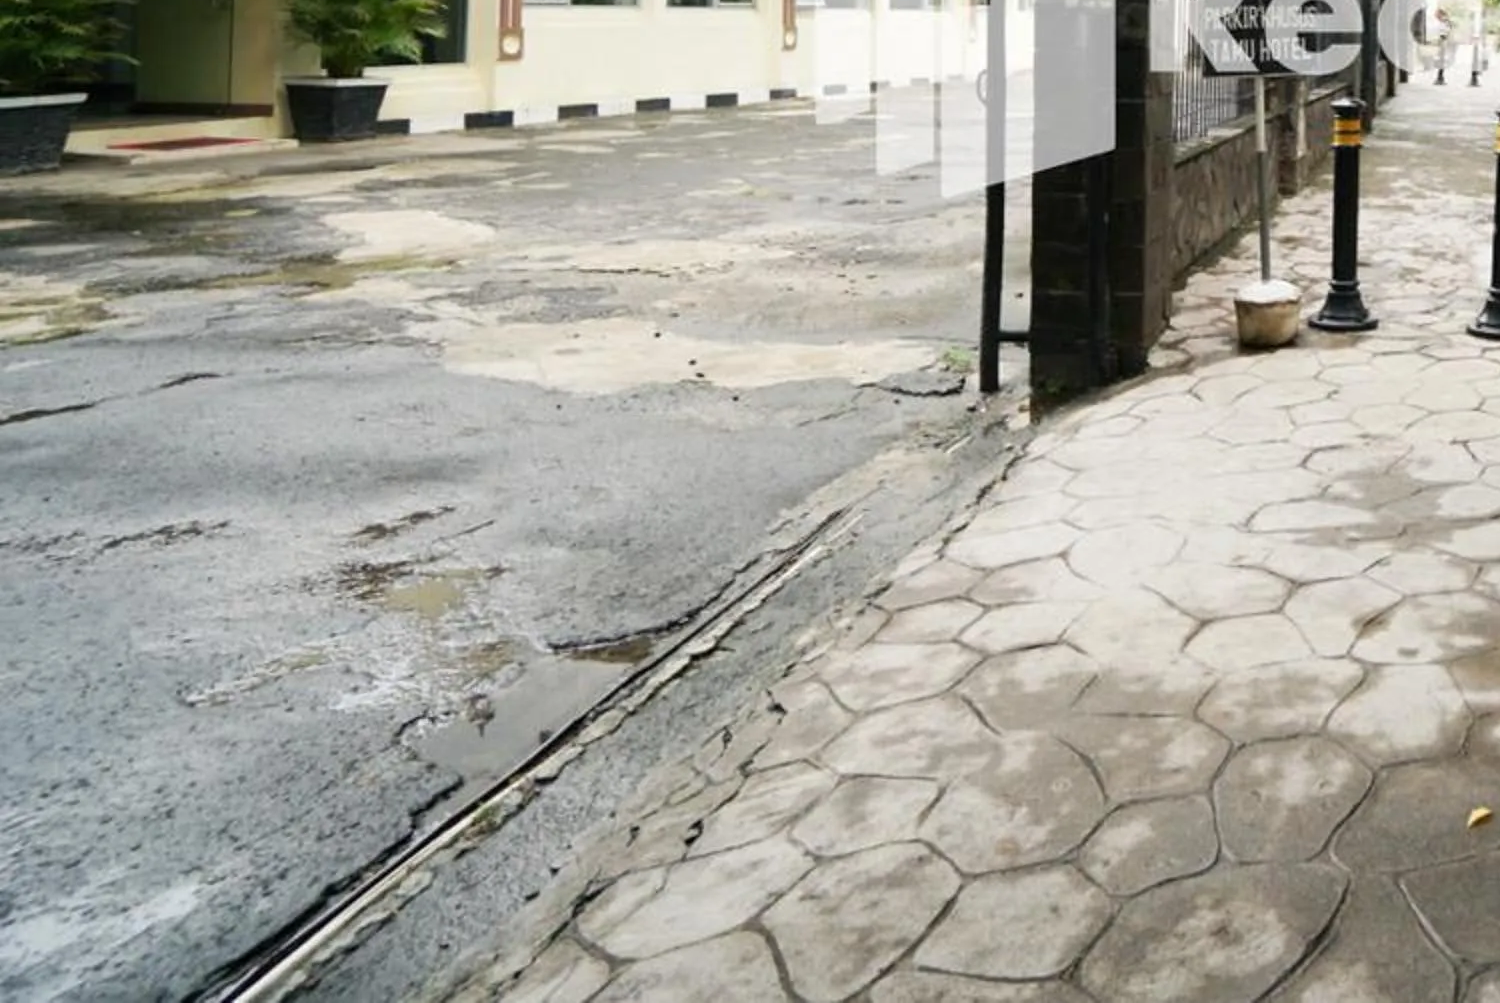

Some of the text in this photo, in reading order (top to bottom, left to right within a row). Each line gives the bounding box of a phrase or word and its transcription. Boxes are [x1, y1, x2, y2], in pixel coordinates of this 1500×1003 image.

[1204, 5, 1318, 30] PARKIR KHUSUS
[1211, 37, 1312, 62] TAMU HOTEL
